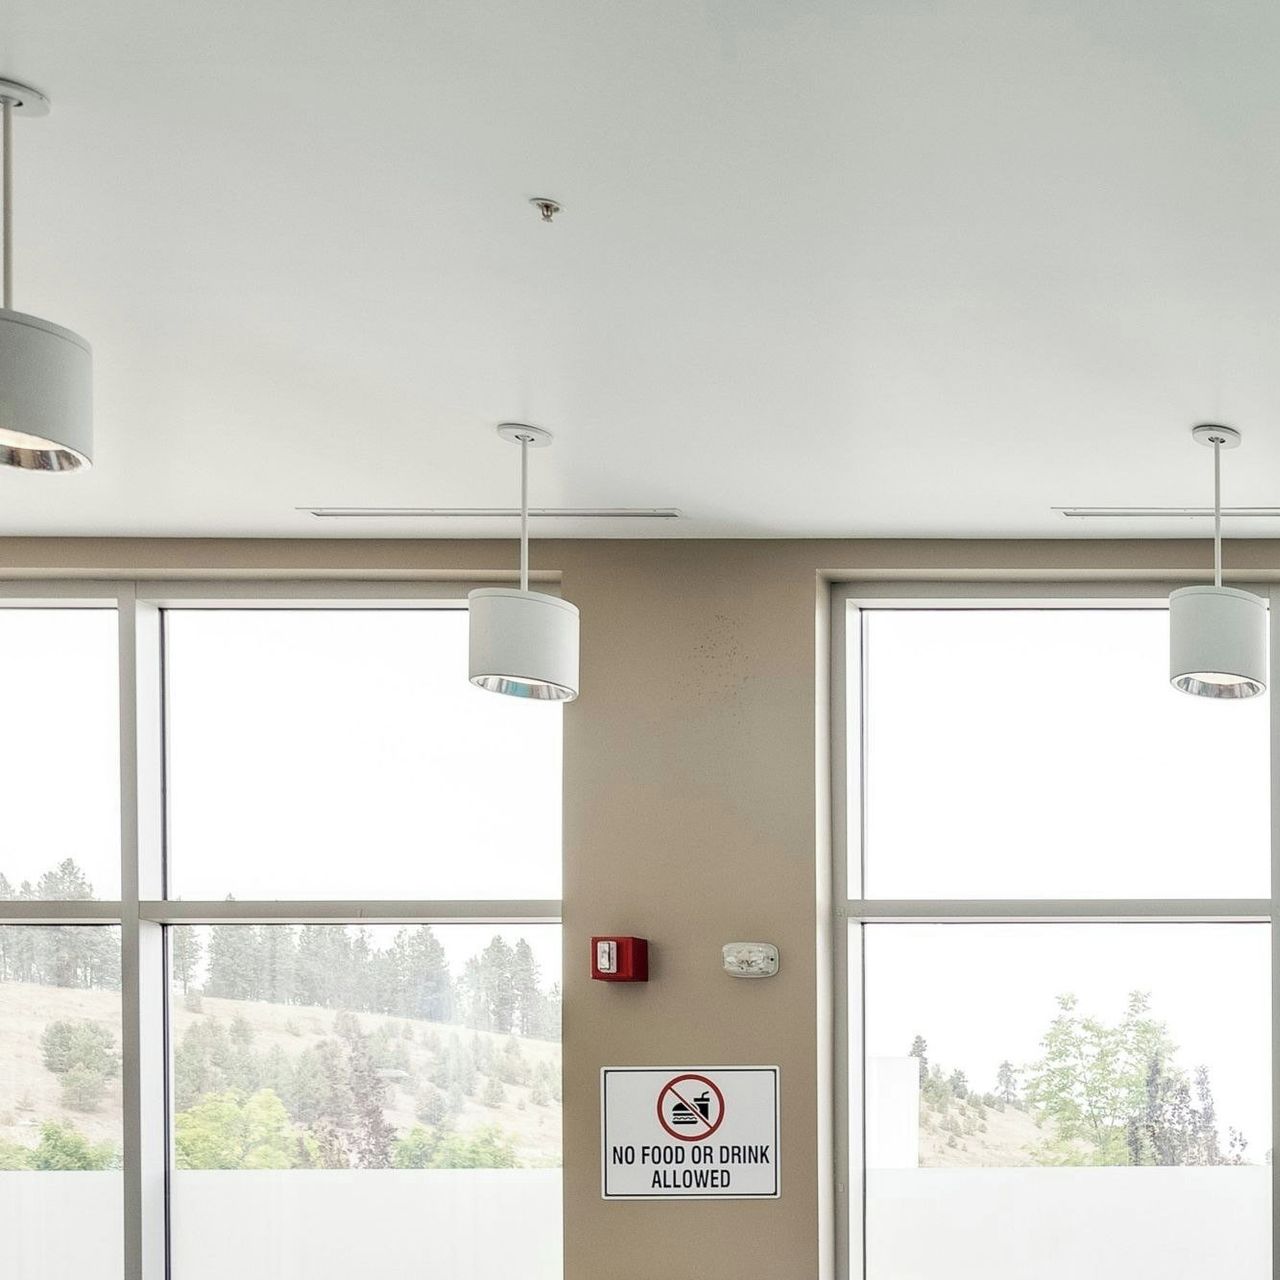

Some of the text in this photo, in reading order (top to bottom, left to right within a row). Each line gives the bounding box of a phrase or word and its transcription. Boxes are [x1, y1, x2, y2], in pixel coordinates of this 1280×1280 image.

[612, 1145, 770, 1165] NO FOOD OR DRINK
[651, 1169, 731, 1189] ALLOWED
